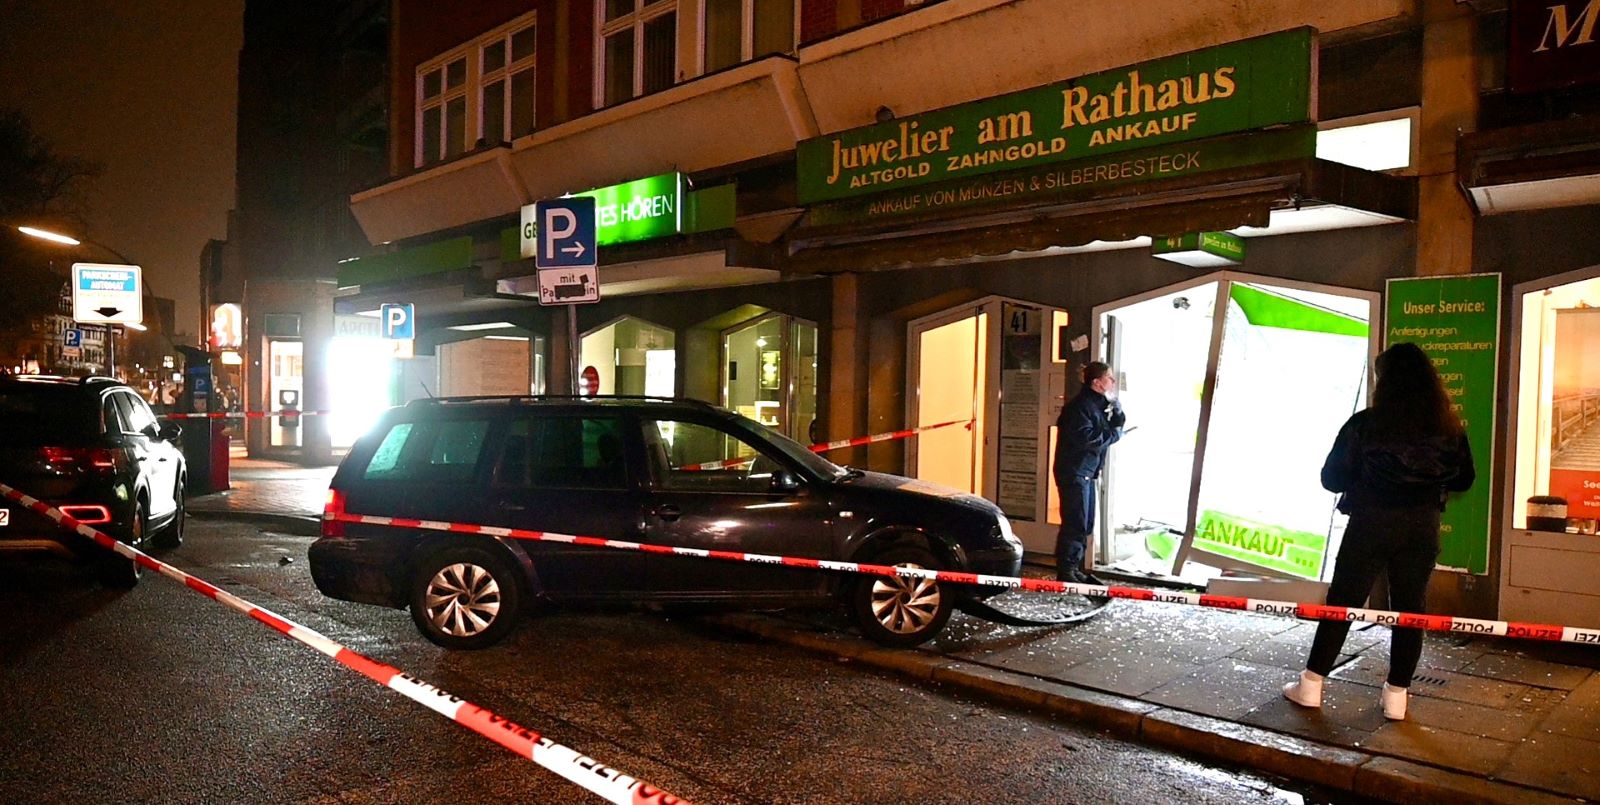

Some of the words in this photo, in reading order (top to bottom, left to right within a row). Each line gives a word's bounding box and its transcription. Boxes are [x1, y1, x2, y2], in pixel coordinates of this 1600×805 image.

[826, 121, 954, 184] Juwelier
[978, 109, 1033, 145] am
[1061, 66, 1236, 129] Rathaus
[850, 161, 931, 188] ALTGOLD
[947, 137, 1066, 171] ZAHNGOLD
[1088, 112, 1197, 147] ANKAUF
[868, 194, 921, 216] ANKAUF
[926, 190, 955, 207] VON
[1030, 175, 1041, 191] &
[1045, 151, 1200, 189] SILBERBESTECK
[621, 194, 673, 223] HÖREN
[545, 208, 577, 260] P
[559, 274, 576, 284] mit
[388, 307, 407, 336] P
[1011, 310, 1028, 332] 41
[1403, 301, 1436, 314] Unser
[1439, 300, 1485, 313] Service:
[66, 331, 76, 345] P
[1390, 326, 1458, 338] Anfertigungen
[195, 378, 205, 390] P
[1202, 518, 1294, 557] ANKAUF
[1255, 603, 1304, 615] POLIZEI
[1376, 614, 1429, 627] POLIZEI
[1440, 620, 1494, 633] POLIZEI
[1507, 626, 1563, 640] POLIZEI
